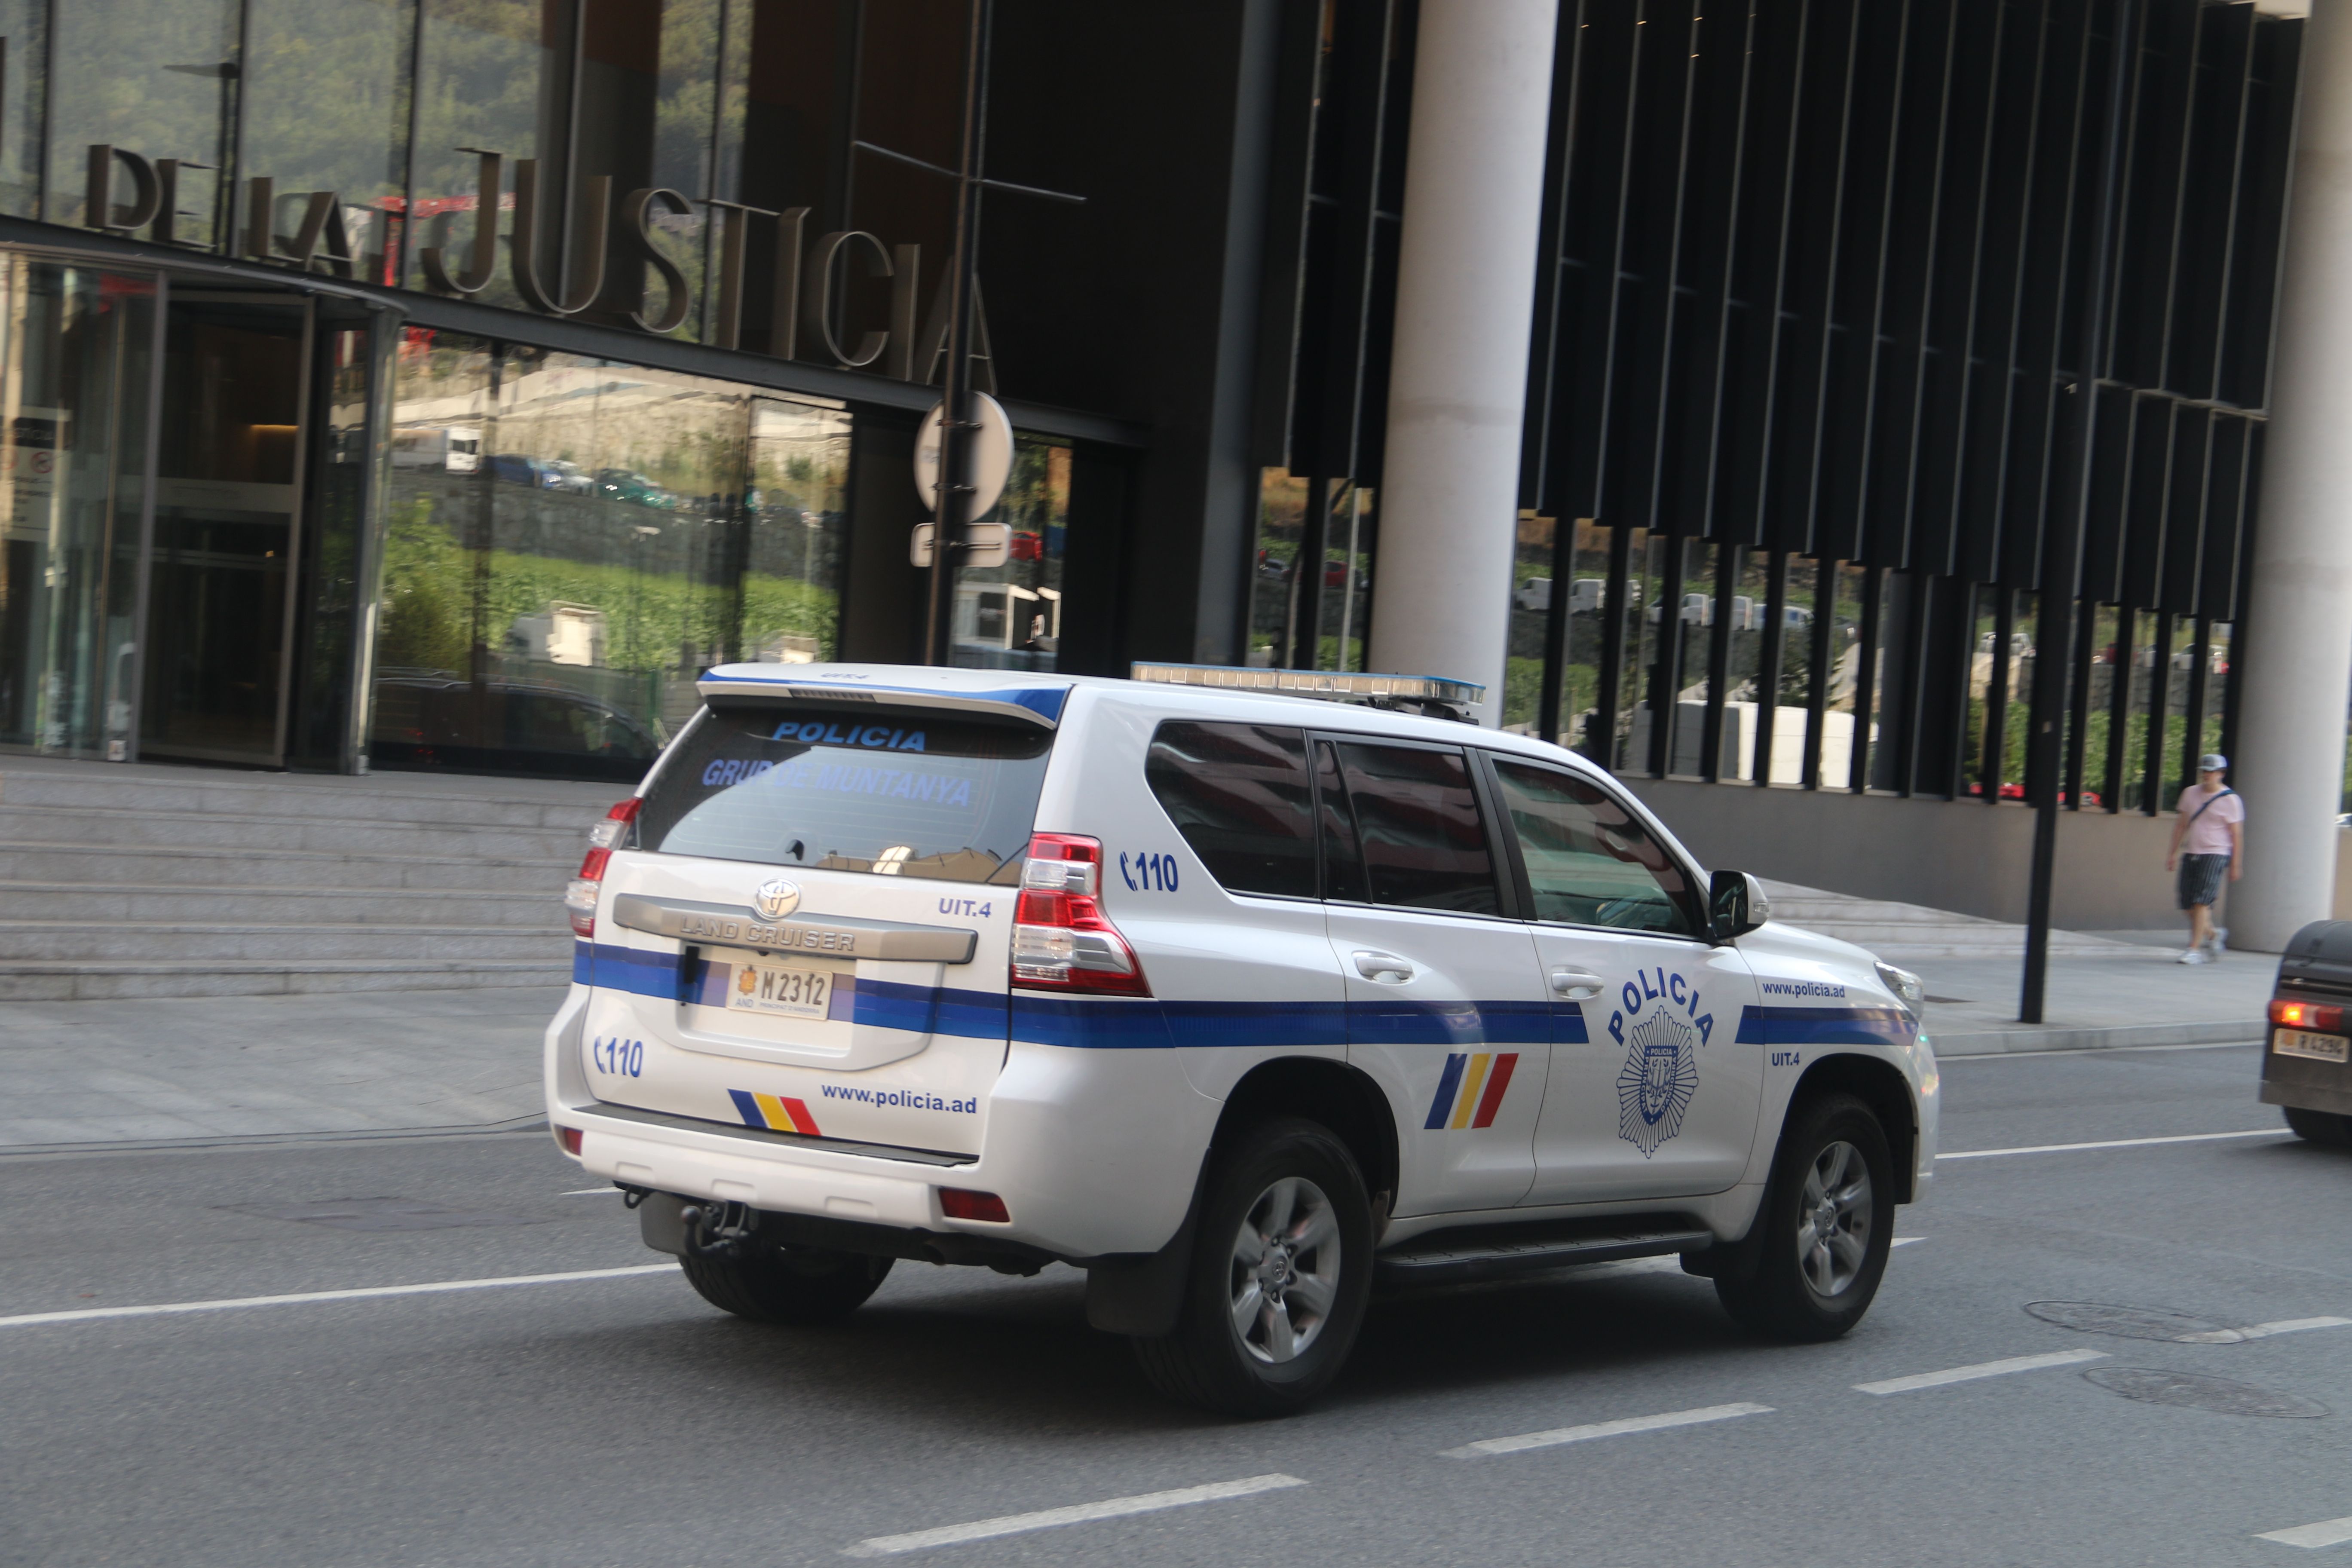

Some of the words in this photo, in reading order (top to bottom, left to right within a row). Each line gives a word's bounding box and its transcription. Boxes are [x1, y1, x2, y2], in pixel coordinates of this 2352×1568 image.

[86, 144, 220, 248] DE
[247, 176, 353, 280] LA
[420, 147, 998, 396] JUSTICIA
[773, 722, 926, 751] POLICIA
[701, 759, 774, 786] GRUP
[773, 761, 815, 789] DE
[815, 765, 971, 807] MUNTANYA
[1136, 851, 1178, 892] 110
[939, 897, 992, 918] UIT.4
[680, 916, 738, 939] LAND
[746, 923, 855, 951] CRUISER
[735, 998, 754, 1008] AND
[1608, 967, 1714, 1047] POLICIA
[1763, 982, 1845, 998] www.policia.ad
[606, 1037, 643, 1078] 110
[1772, 1052, 1800, 1066] UIT.4
[821, 1084, 977, 1114] www.policia.ad
[1641, 1057, 1649, 1113] PRINCIPAT
